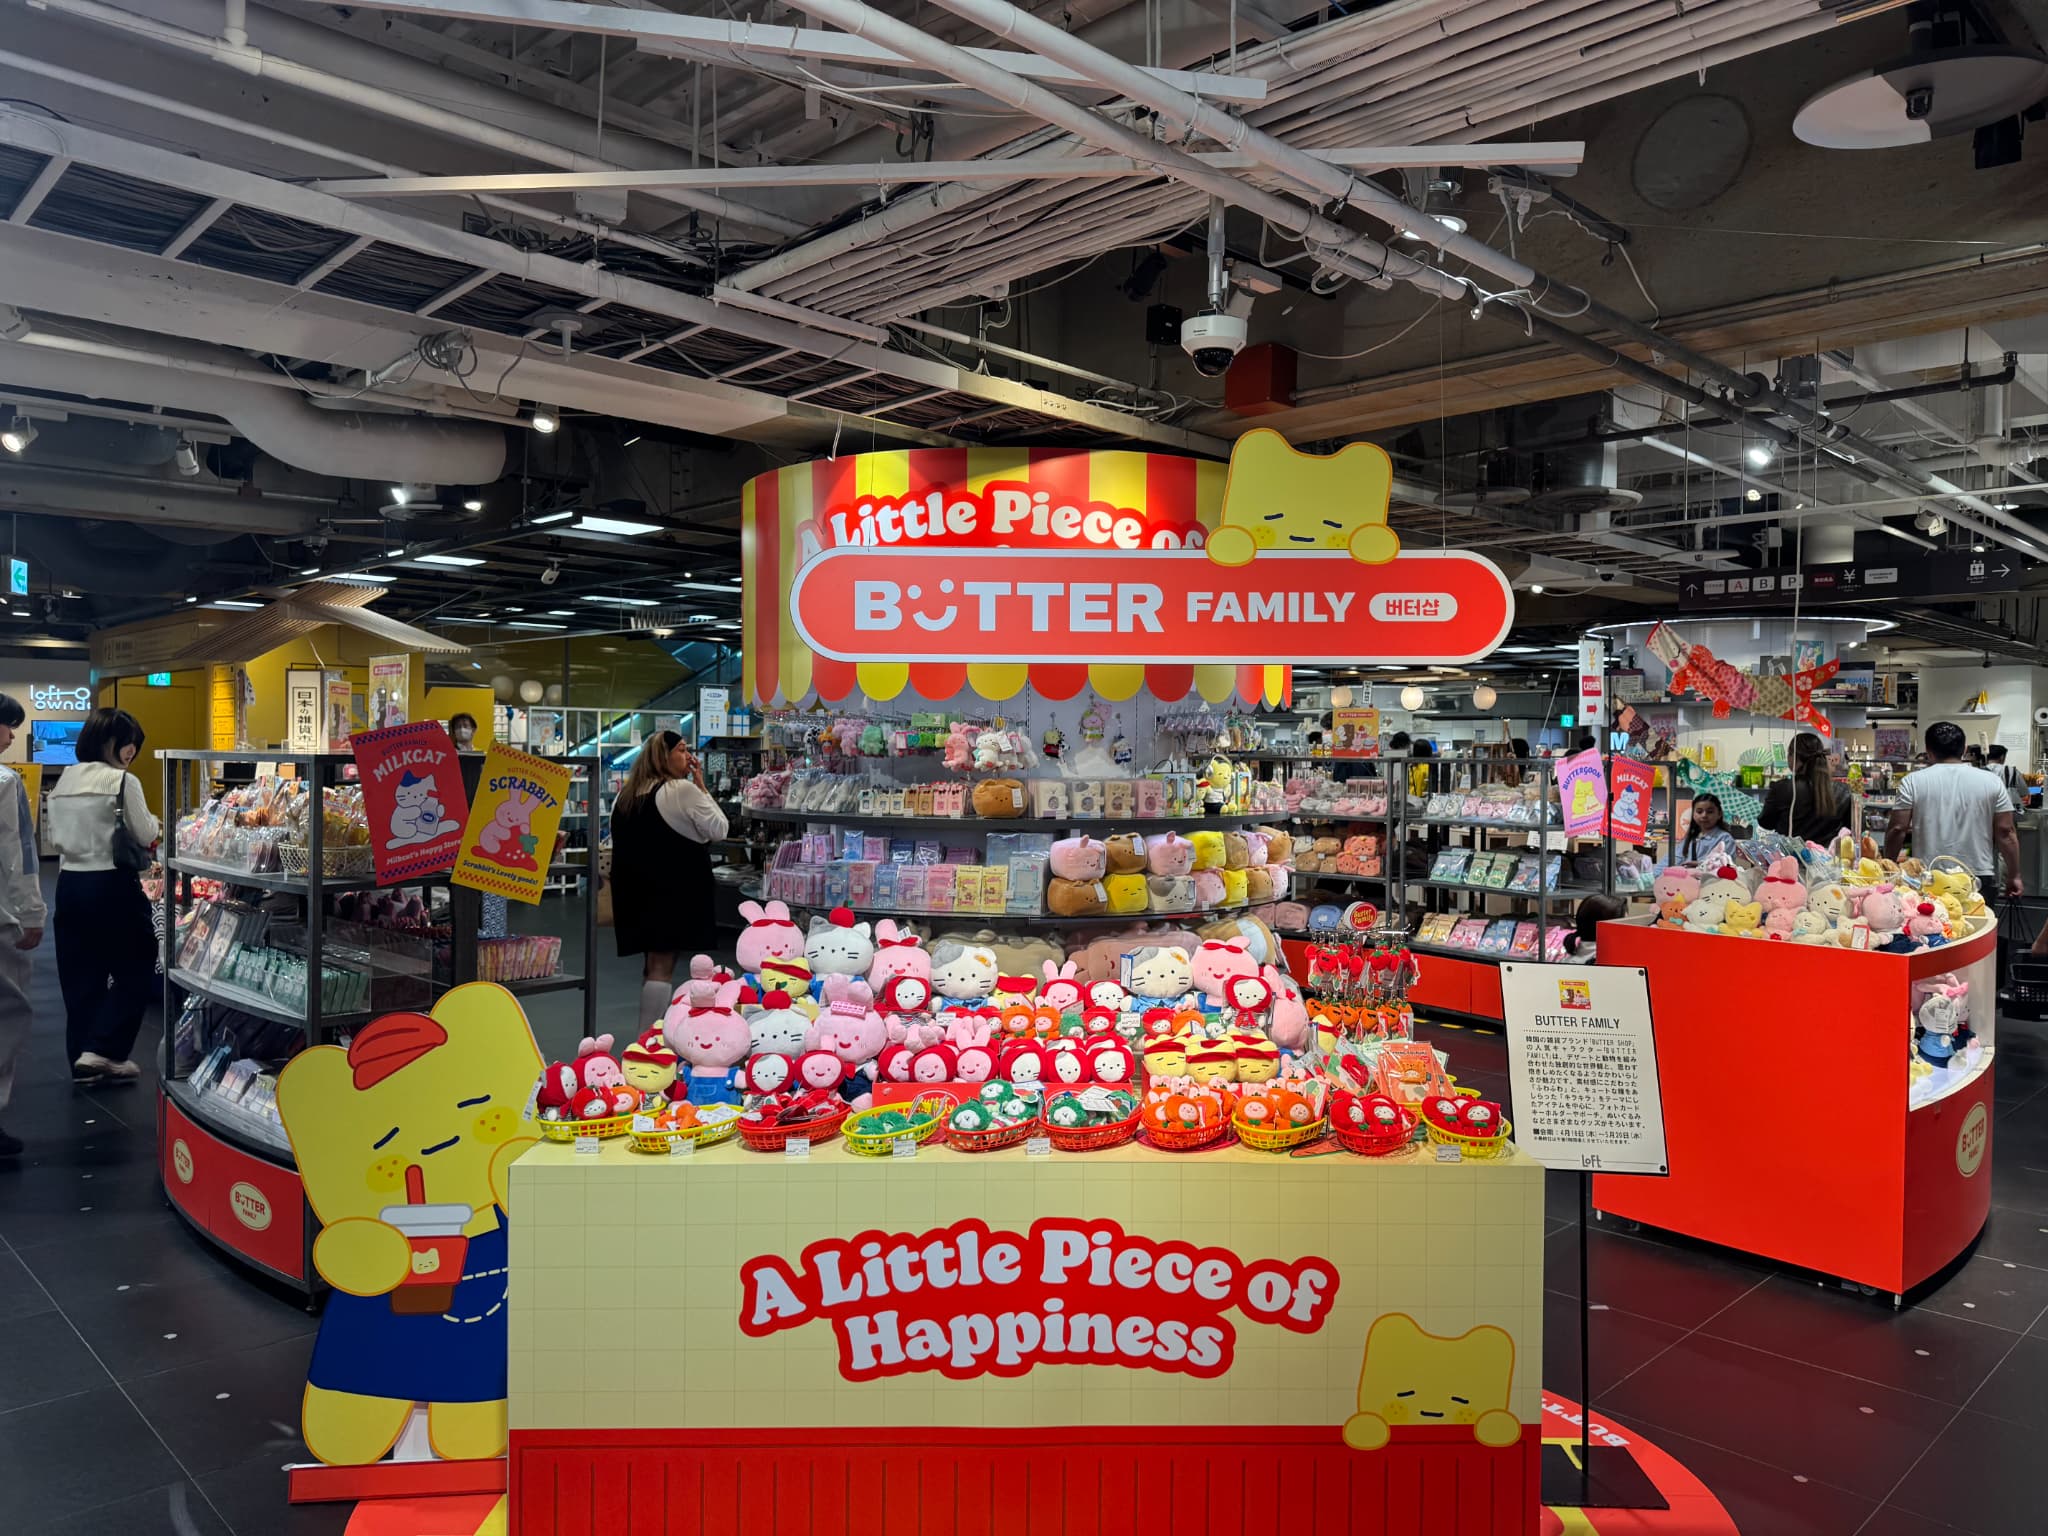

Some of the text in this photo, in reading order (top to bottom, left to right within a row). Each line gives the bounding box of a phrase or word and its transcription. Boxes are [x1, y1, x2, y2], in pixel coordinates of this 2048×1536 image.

[830, 492, 977, 547] Little
[992, 490, 1142, 549] Piece
[1186, 591, 1356, 623] FAMILY
[1385, 598, 1440, 617] 버터샵
[372, 748, 447, 783] MILKCAT
[489, 776, 558, 809] SCRABBIT
[1535, 1015, 1620, 1029] BUTTER FAMILY
[751, 1229, 1329, 1325] A Little Piece of
[843, 1297, 1225, 1370] Happiness
